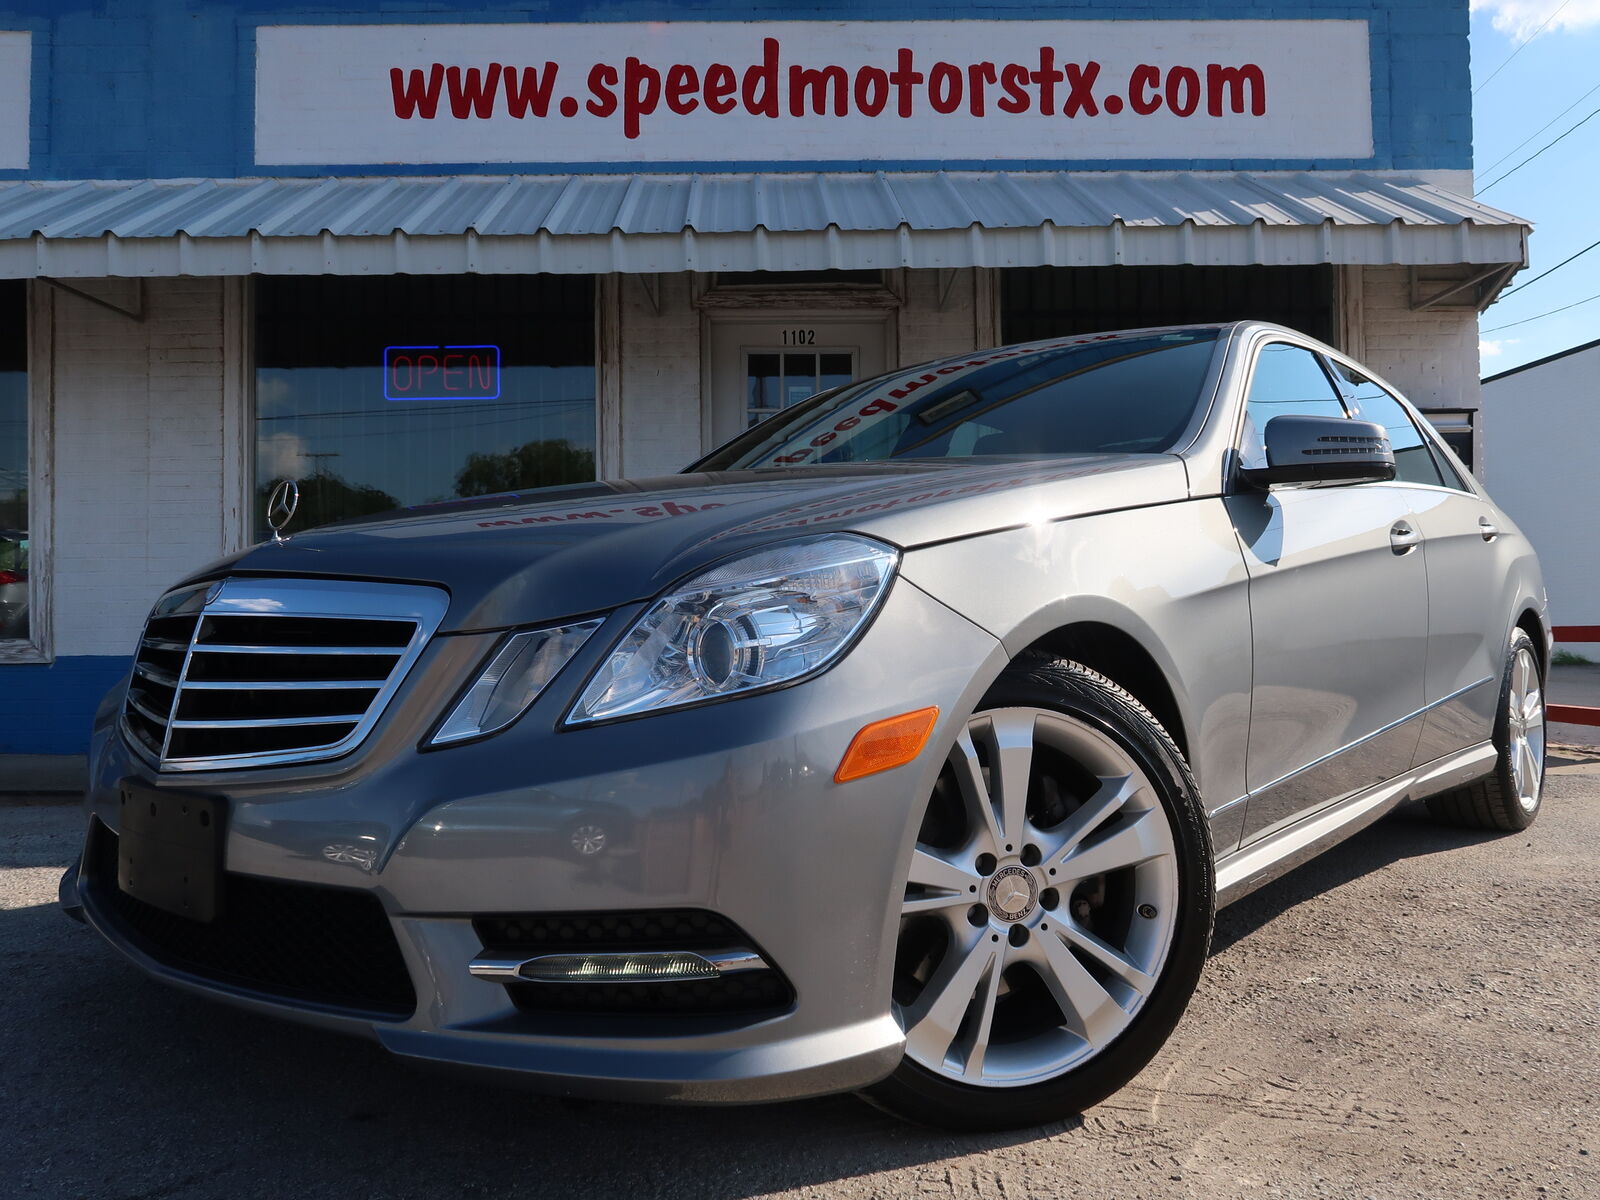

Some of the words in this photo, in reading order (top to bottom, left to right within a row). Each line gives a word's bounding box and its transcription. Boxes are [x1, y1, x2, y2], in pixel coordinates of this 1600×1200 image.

[390, 37, 1265, 138] www.speedmotorstx.com
[782, 329, 816, 345] 1102
[392, 354, 491, 391] OPEN
